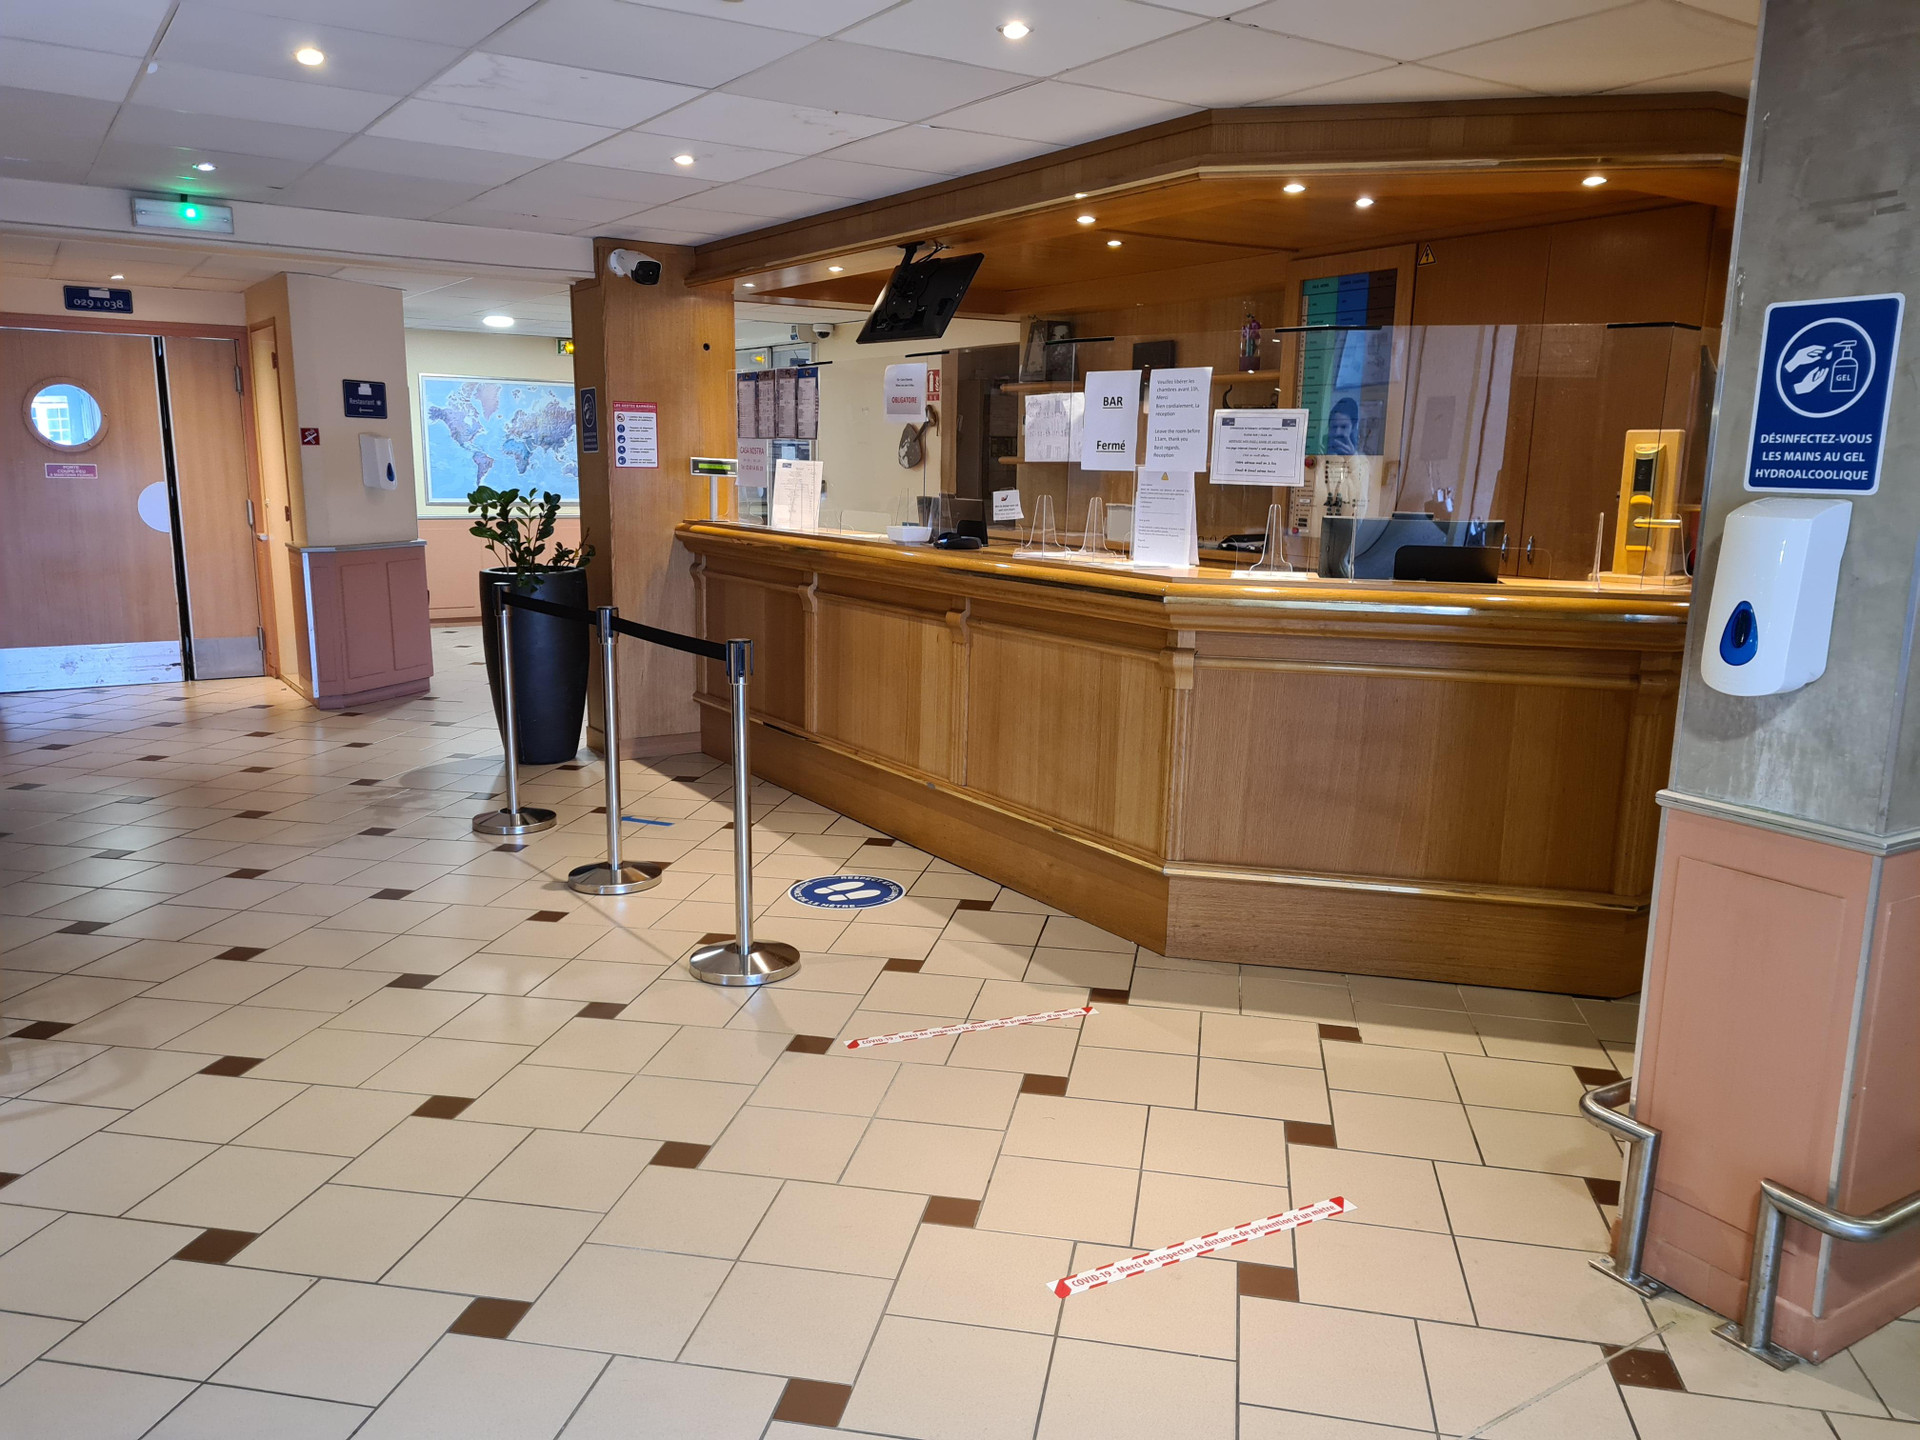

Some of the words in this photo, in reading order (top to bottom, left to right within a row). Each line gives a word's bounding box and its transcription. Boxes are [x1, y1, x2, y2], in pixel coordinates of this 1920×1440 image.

[74, 298, 94, 308] 029
[104, 300, 124, 309] 038
[1103, 396, 1123, 406] BAR
[1760, 432, 1872, 444] DÉSINFECTEZ-VOUS
[1096, 440, 1125, 451] Fermé
[1762, 452, 1781, 461] LES
[1784, 452, 1821, 461] MAINS
[1823, 452, 1840, 461] AU
[1843, 452, 1865, 462] GEL
[1755, 469, 1869, 481] HYDROALCOOLIQUE
[1010, 1016, 1046, 1024] prévention
[1072, 1271, 1112, 1287] COVID-19
[1117, 1261, 1142, 1274] Merci
[1143, 1257, 1154, 1266] de
[1155, 1246, 1195, 1264] respecter
[1195, 1242, 1204, 1250] la
[1204, 1233, 1239, 1248] distance
[1239, 1228, 1250, 1237] de
[1251, 1217, 1294, 1235] prévention
[1312, 1204, 1335, 1216] mètre
